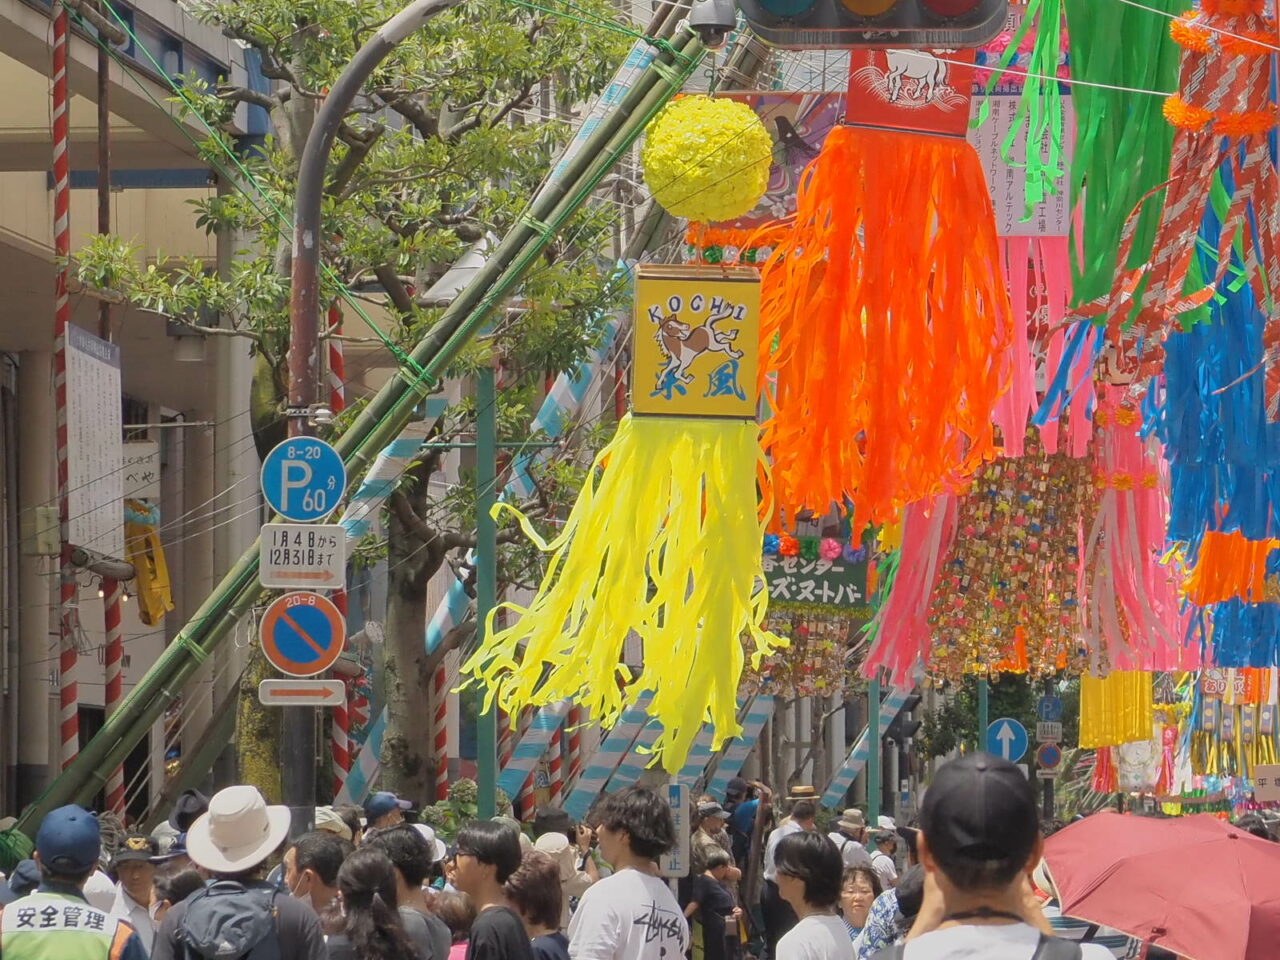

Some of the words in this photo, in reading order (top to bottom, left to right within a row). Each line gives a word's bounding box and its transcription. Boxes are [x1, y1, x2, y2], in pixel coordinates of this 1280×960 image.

[648, 295, 746, 322] KOCHI
[288, 446, 321, 460] 8-20
[280, 460, 312, 512] P
[302, 489, 326, 512] 60
[269, 548, 335, 566] 12月31日まで
[285, 595, 316, 609] 20-8
[16, 905, 105, 930] 安全管理
